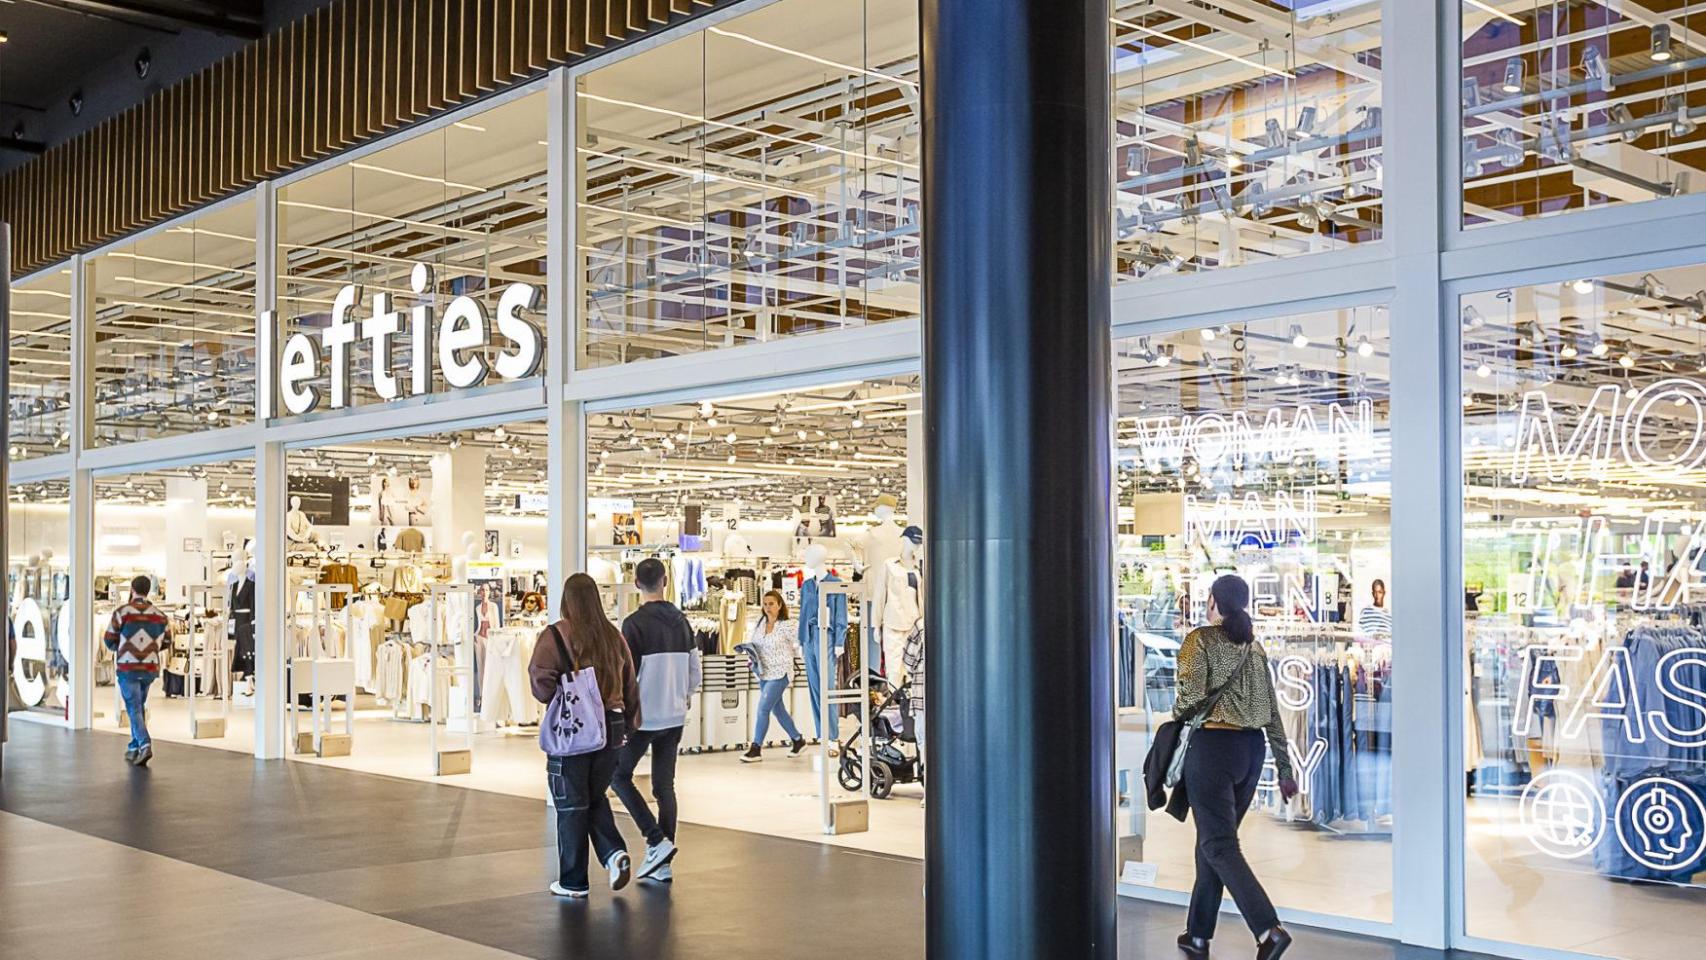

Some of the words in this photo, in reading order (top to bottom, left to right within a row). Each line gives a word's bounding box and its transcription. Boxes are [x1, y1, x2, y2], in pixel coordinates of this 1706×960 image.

[260, 262, 544, 420] lefties
[1135, 398, 1372, 471] WOMAN
[726, 518, 737, 530] 12
[1183, 490, 1313, 547] MAN
[490, 567, 500, 577] 17
[785, 591, 795, 601] 15
[1180, 573, 1323, 623] TEN
[1513, 592, 1528, 607] 12
